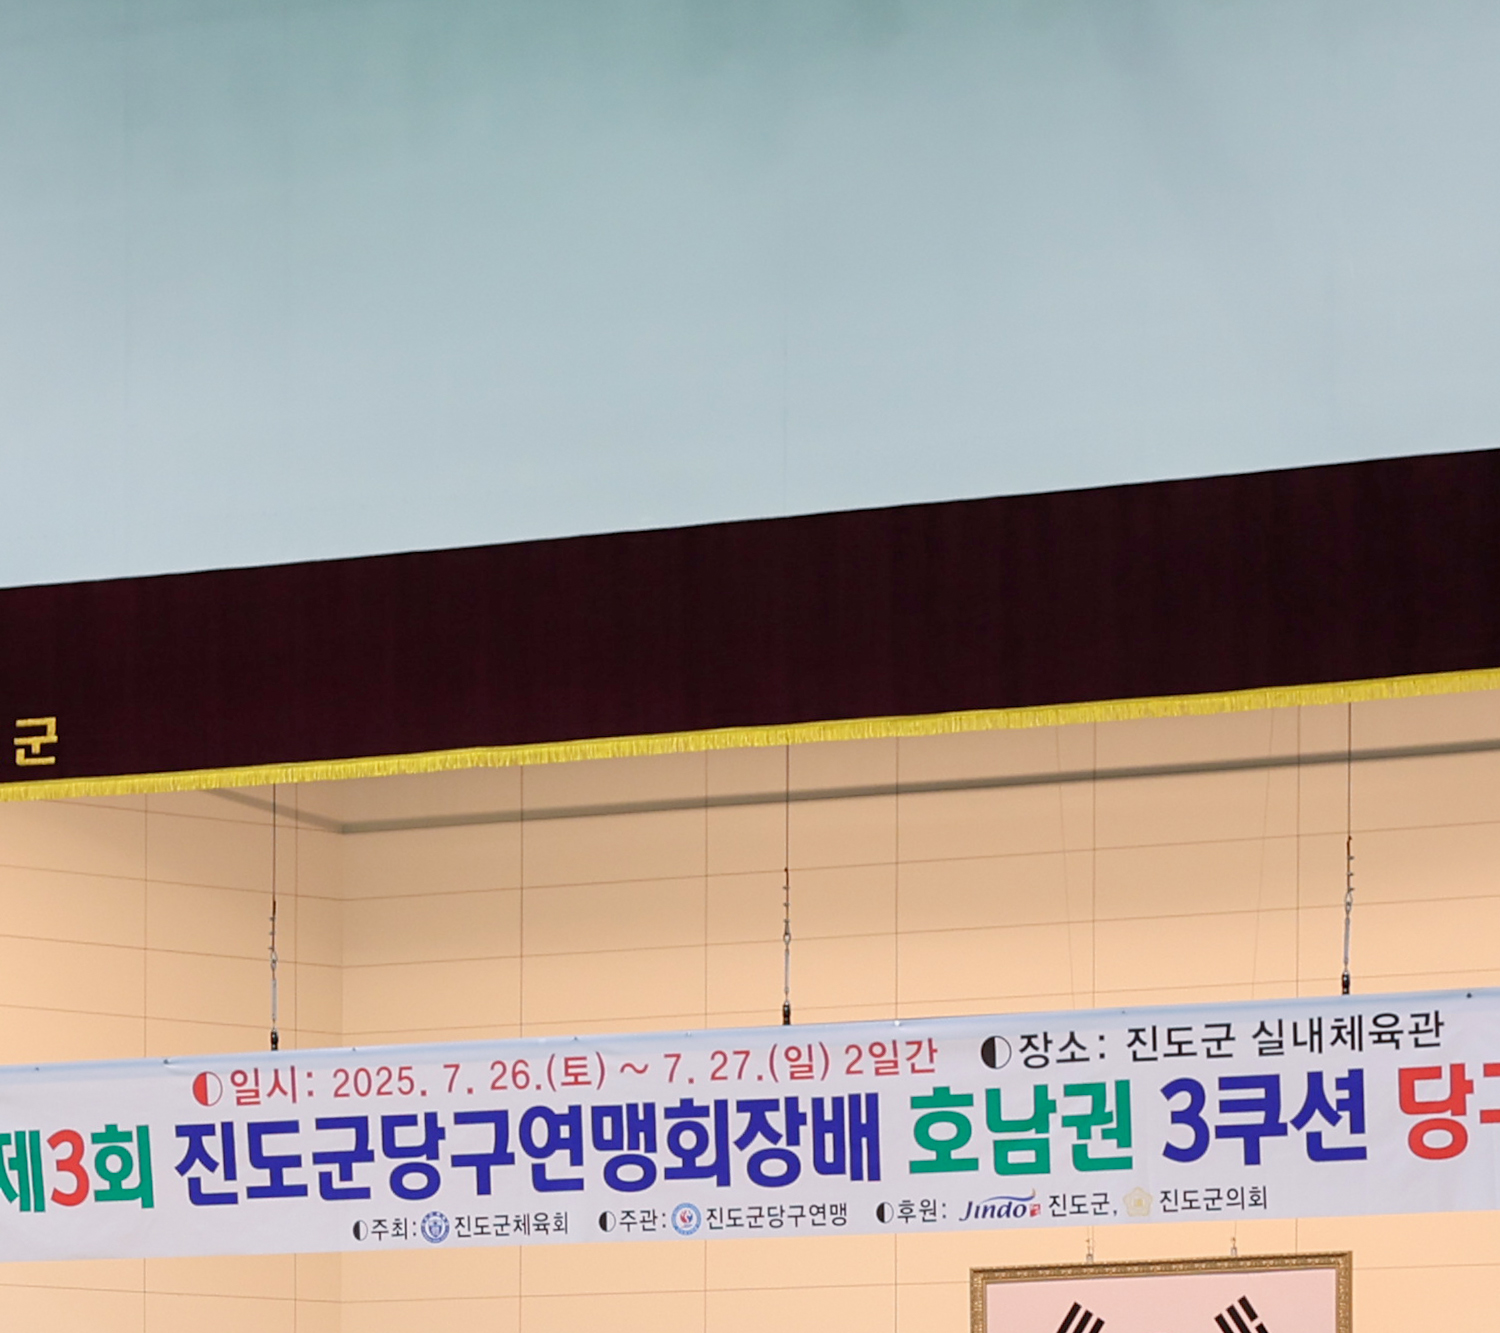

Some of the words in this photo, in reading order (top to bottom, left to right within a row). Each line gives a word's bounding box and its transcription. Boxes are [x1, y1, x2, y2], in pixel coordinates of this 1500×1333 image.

[1018, 1030, 1106, 1068] 장소:
[1125, 1020, 1237, 1063] 진도군
[1251, 1009, 1445, 1057] 실내체육관
[230, 1066, 314, 1106] 일시:
[332, 1066, 428, 1099] 2025.
[844, 1038, 939, 1076] 2일간
[173, 1092, 882, 1207] 진도군당구연맹회장배
[908, 1079, 1134, 1178] 호남권
[1159, 1067, 1369, 1167] 3쿠션
[369, 1217, 417, 1241] 주최:
[453, 1211, 569, 1239] 진도군체육회
[619, 1209, 668, 1233] 주관:
[705, 1202, 848, 1230] 진도군당구연맹
[896, 1197, 947, 1222] 후원:
[1159, 1185, 1268, 1212] 진도군의회
